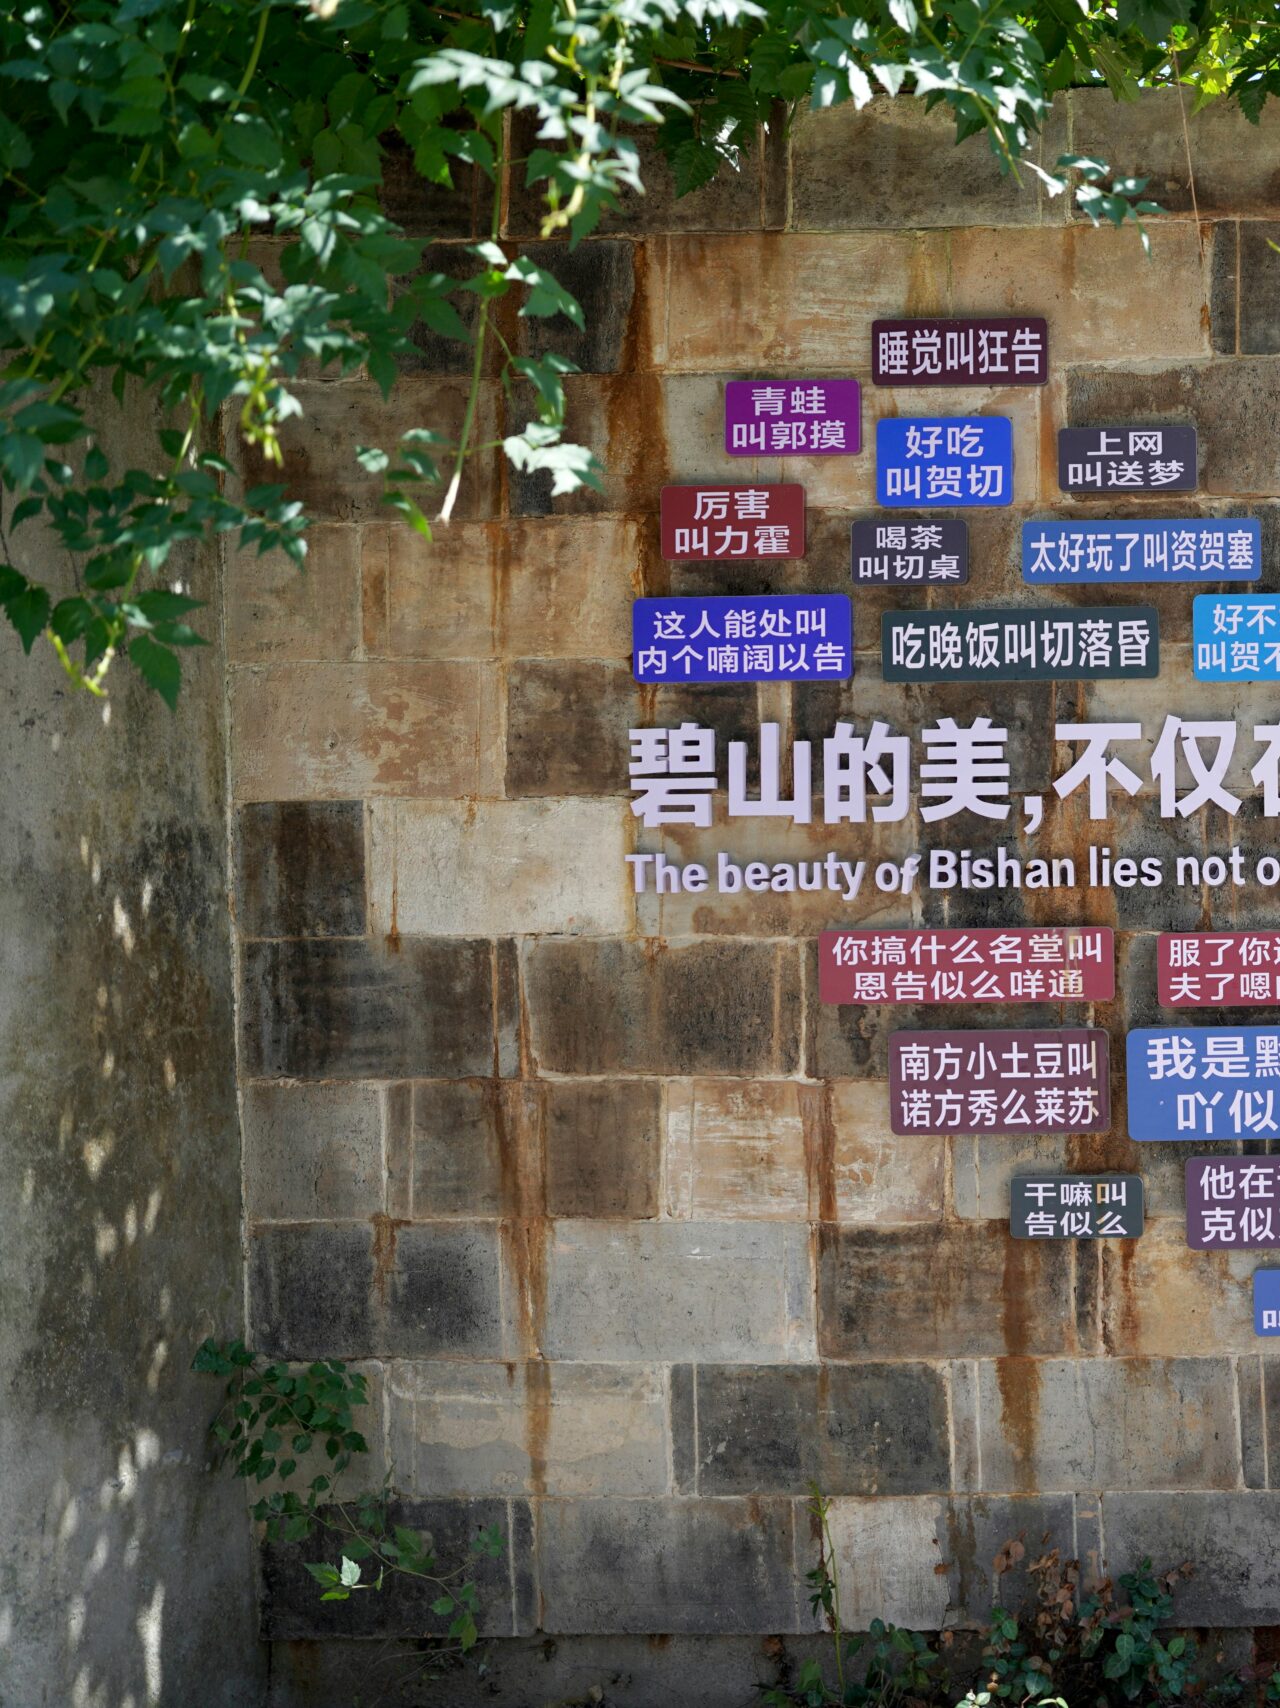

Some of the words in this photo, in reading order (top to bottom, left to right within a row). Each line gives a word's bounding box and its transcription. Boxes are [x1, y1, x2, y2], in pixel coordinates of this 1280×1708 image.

[880, 328, 1041, 375] 睡觉叫狂告
[752, 386, 826, 415] 青蛙
[733, 420, 845, 450] 叫郭摸
[906, 425, 983, 458] 好吃
[1087, 432, 1162, 455] 上网
[887, 465, 1002, 498] 叫贺切
[1069, 460, 1184, 486] 叫送梦
[694, 489, 769, 519] 厉害
[676, 526, 789, 555] 叫力霍
[877, 525, 942, 550] 喝茶
[1031, 530, 1253, 572] 太好玩了叫资贺塞
[860, 555, 959, 580] 叫切桌
[654, 608, 825, 639] 这人能处叫
[639, 642, 845, 674] 内个喃阔以告
[893, 620, 1149, 669] 吃晚饭叫切落昏
[625, 852, 710, 894] The
[717, 851, 866, 901] beauty
[876, 852, 923, 896] of
[929, 845, 1076, 890] Bishan
[1088, 845, 1162, 888] lies
[1175, 845, 1245, 888] not
[833, 933, 1101, 965] 你搞什么名堂叫
[854, 970, 1084, 1000] 恩告似么咩通
[900, 1041, 1096, 1081] 南方小土豆叫
[901, 1087, 1098, 1127] 诺方秀么莱苏
[1025, 1182, 1126, 1206] 干嘛叫
[1025, 1211, 1127, 1237] 告似么
